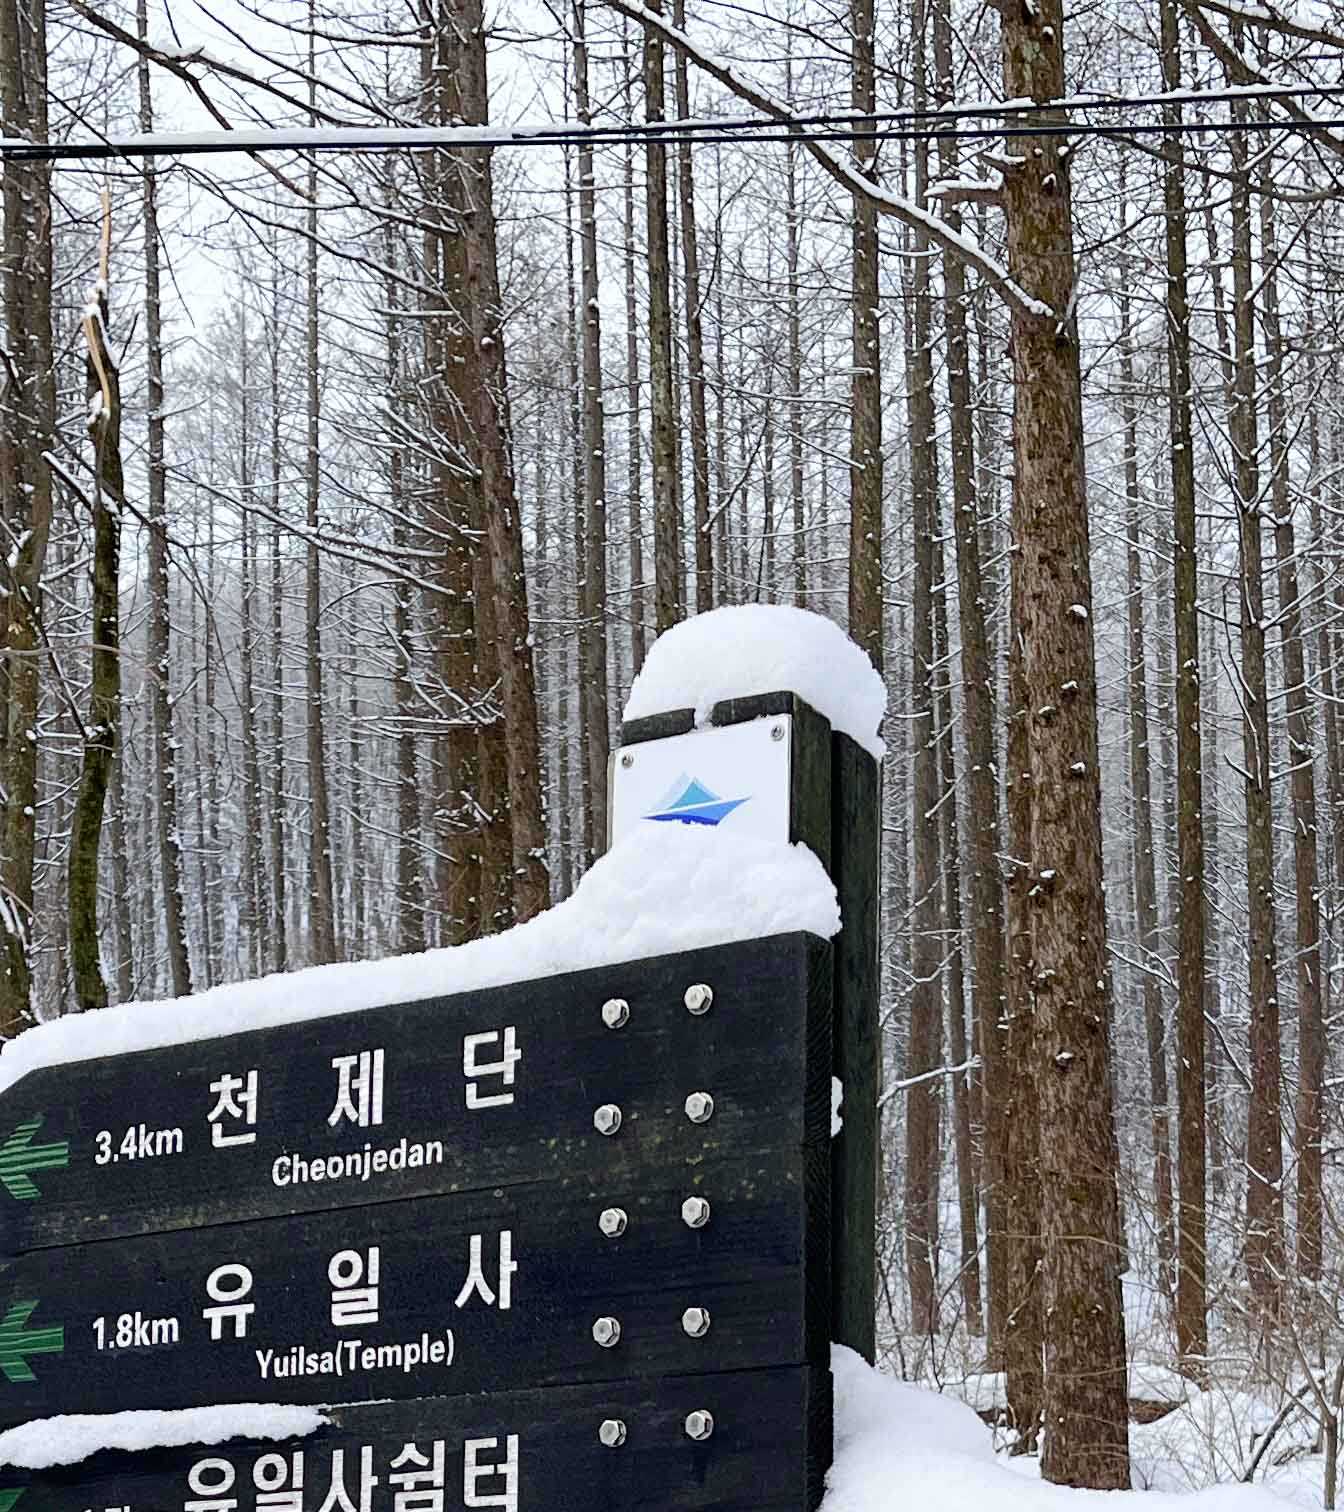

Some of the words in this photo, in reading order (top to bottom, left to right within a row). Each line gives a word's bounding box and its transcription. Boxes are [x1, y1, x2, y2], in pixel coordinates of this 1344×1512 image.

[94, 1123, 183, 1165] 3.4km
[271, 1137, 443, 1187] Cheonjedan
[92, 1311, 180, 1350] 1.8km
[255, 1328, 455, 1379] Yuilsa(Temple)
